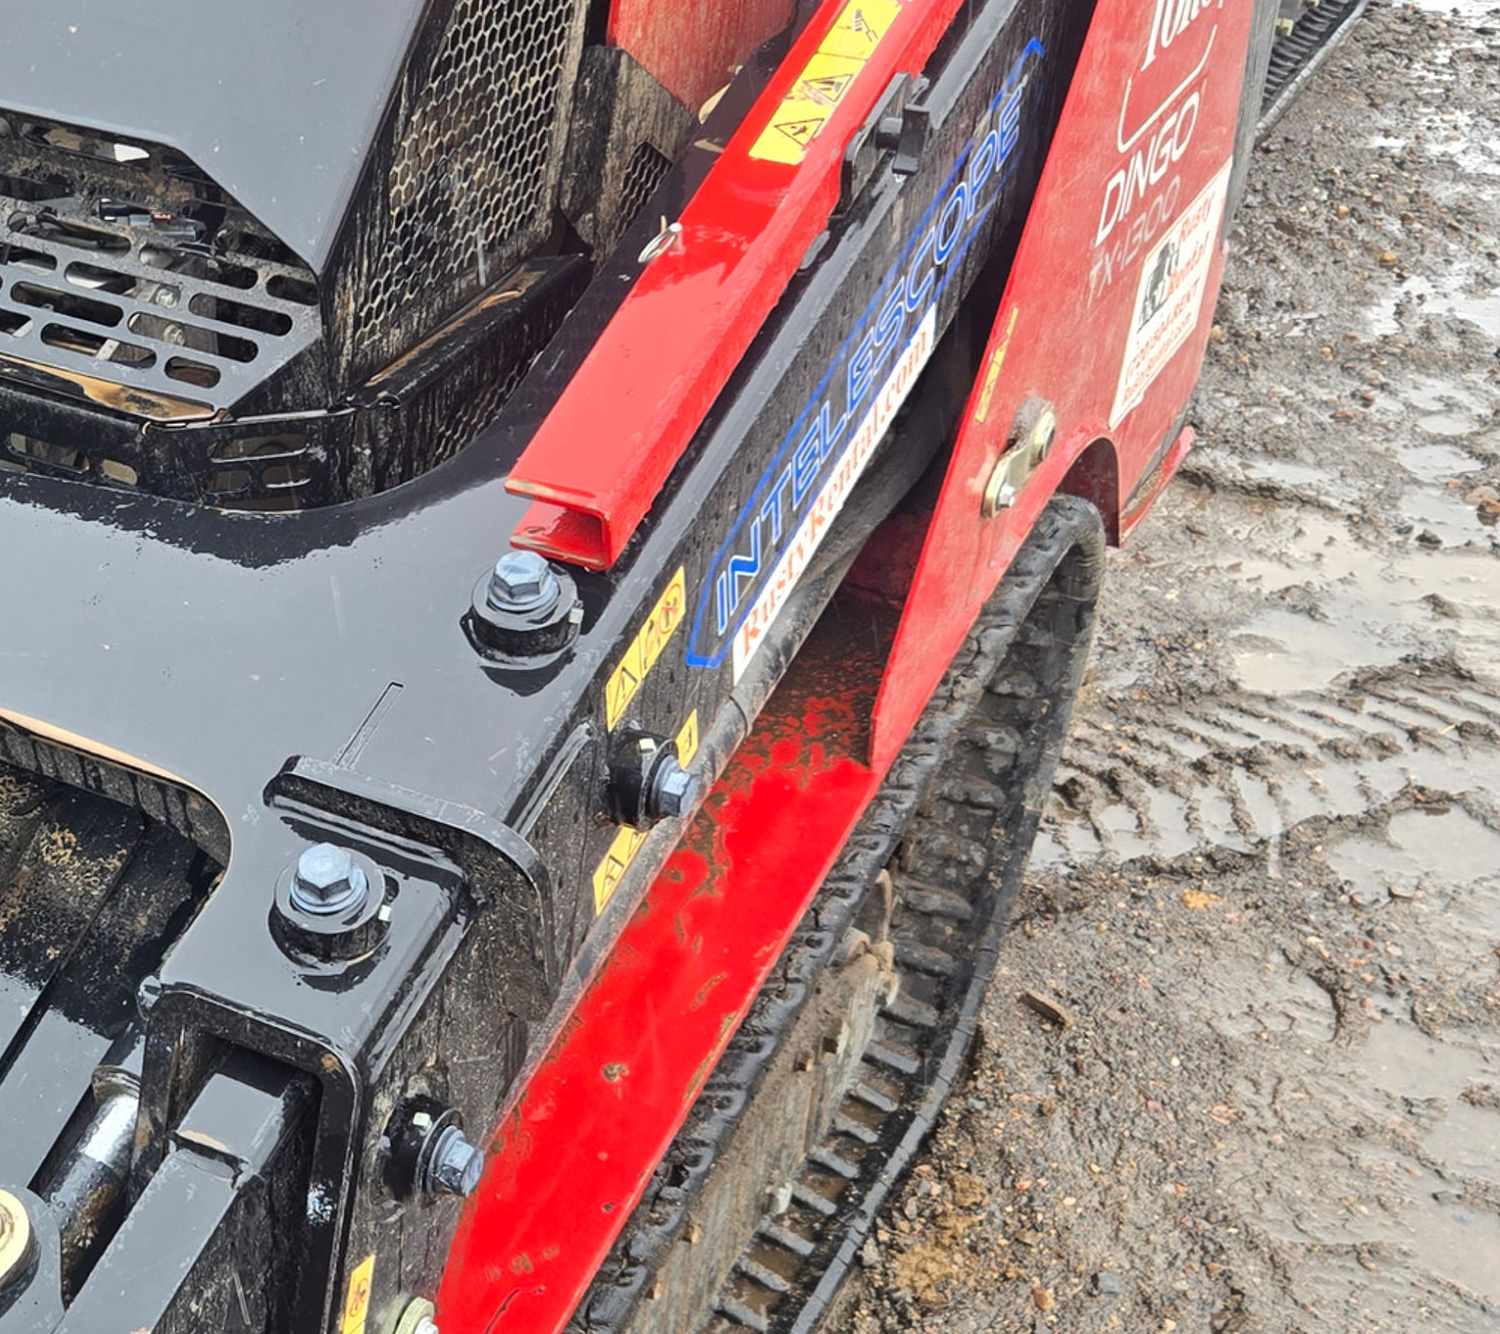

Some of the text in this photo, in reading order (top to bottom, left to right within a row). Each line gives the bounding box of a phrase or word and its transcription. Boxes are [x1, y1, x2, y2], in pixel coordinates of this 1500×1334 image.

[1094, 91, 1199, 248] DINGO
[716, 81, 1023, 637] INTELESCOPE
[740, 329, 928, 653] RustyRental.com
